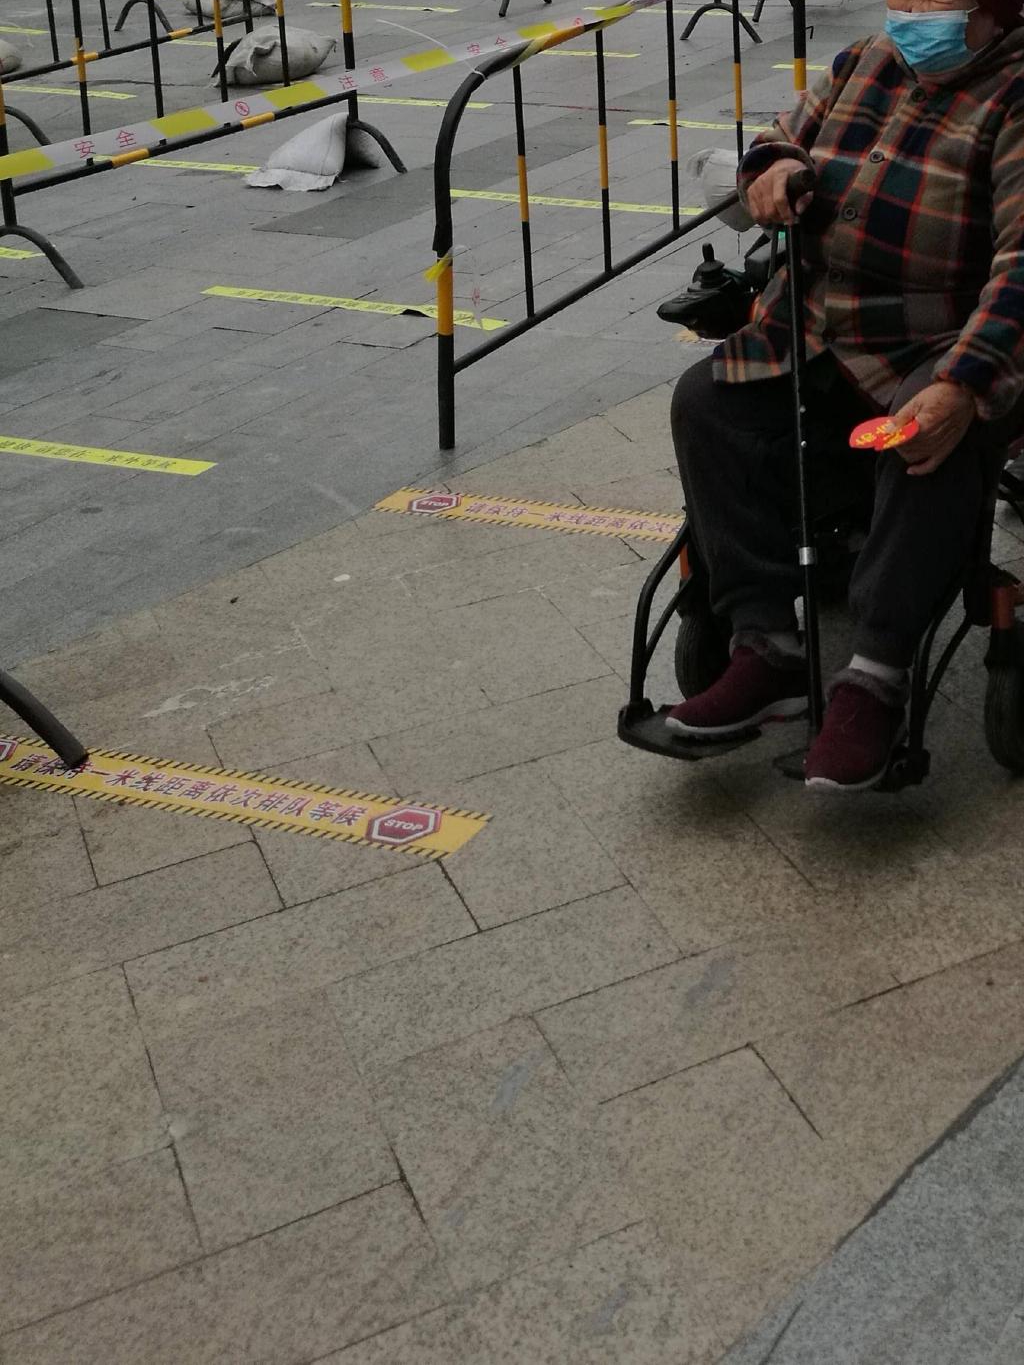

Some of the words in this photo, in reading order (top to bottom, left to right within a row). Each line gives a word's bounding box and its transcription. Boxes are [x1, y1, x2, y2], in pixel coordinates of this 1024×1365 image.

[74, 130, 137, 158] 安全
[338, 66, 389, 91] 注意
[383, 818, 425, 832] STOP
